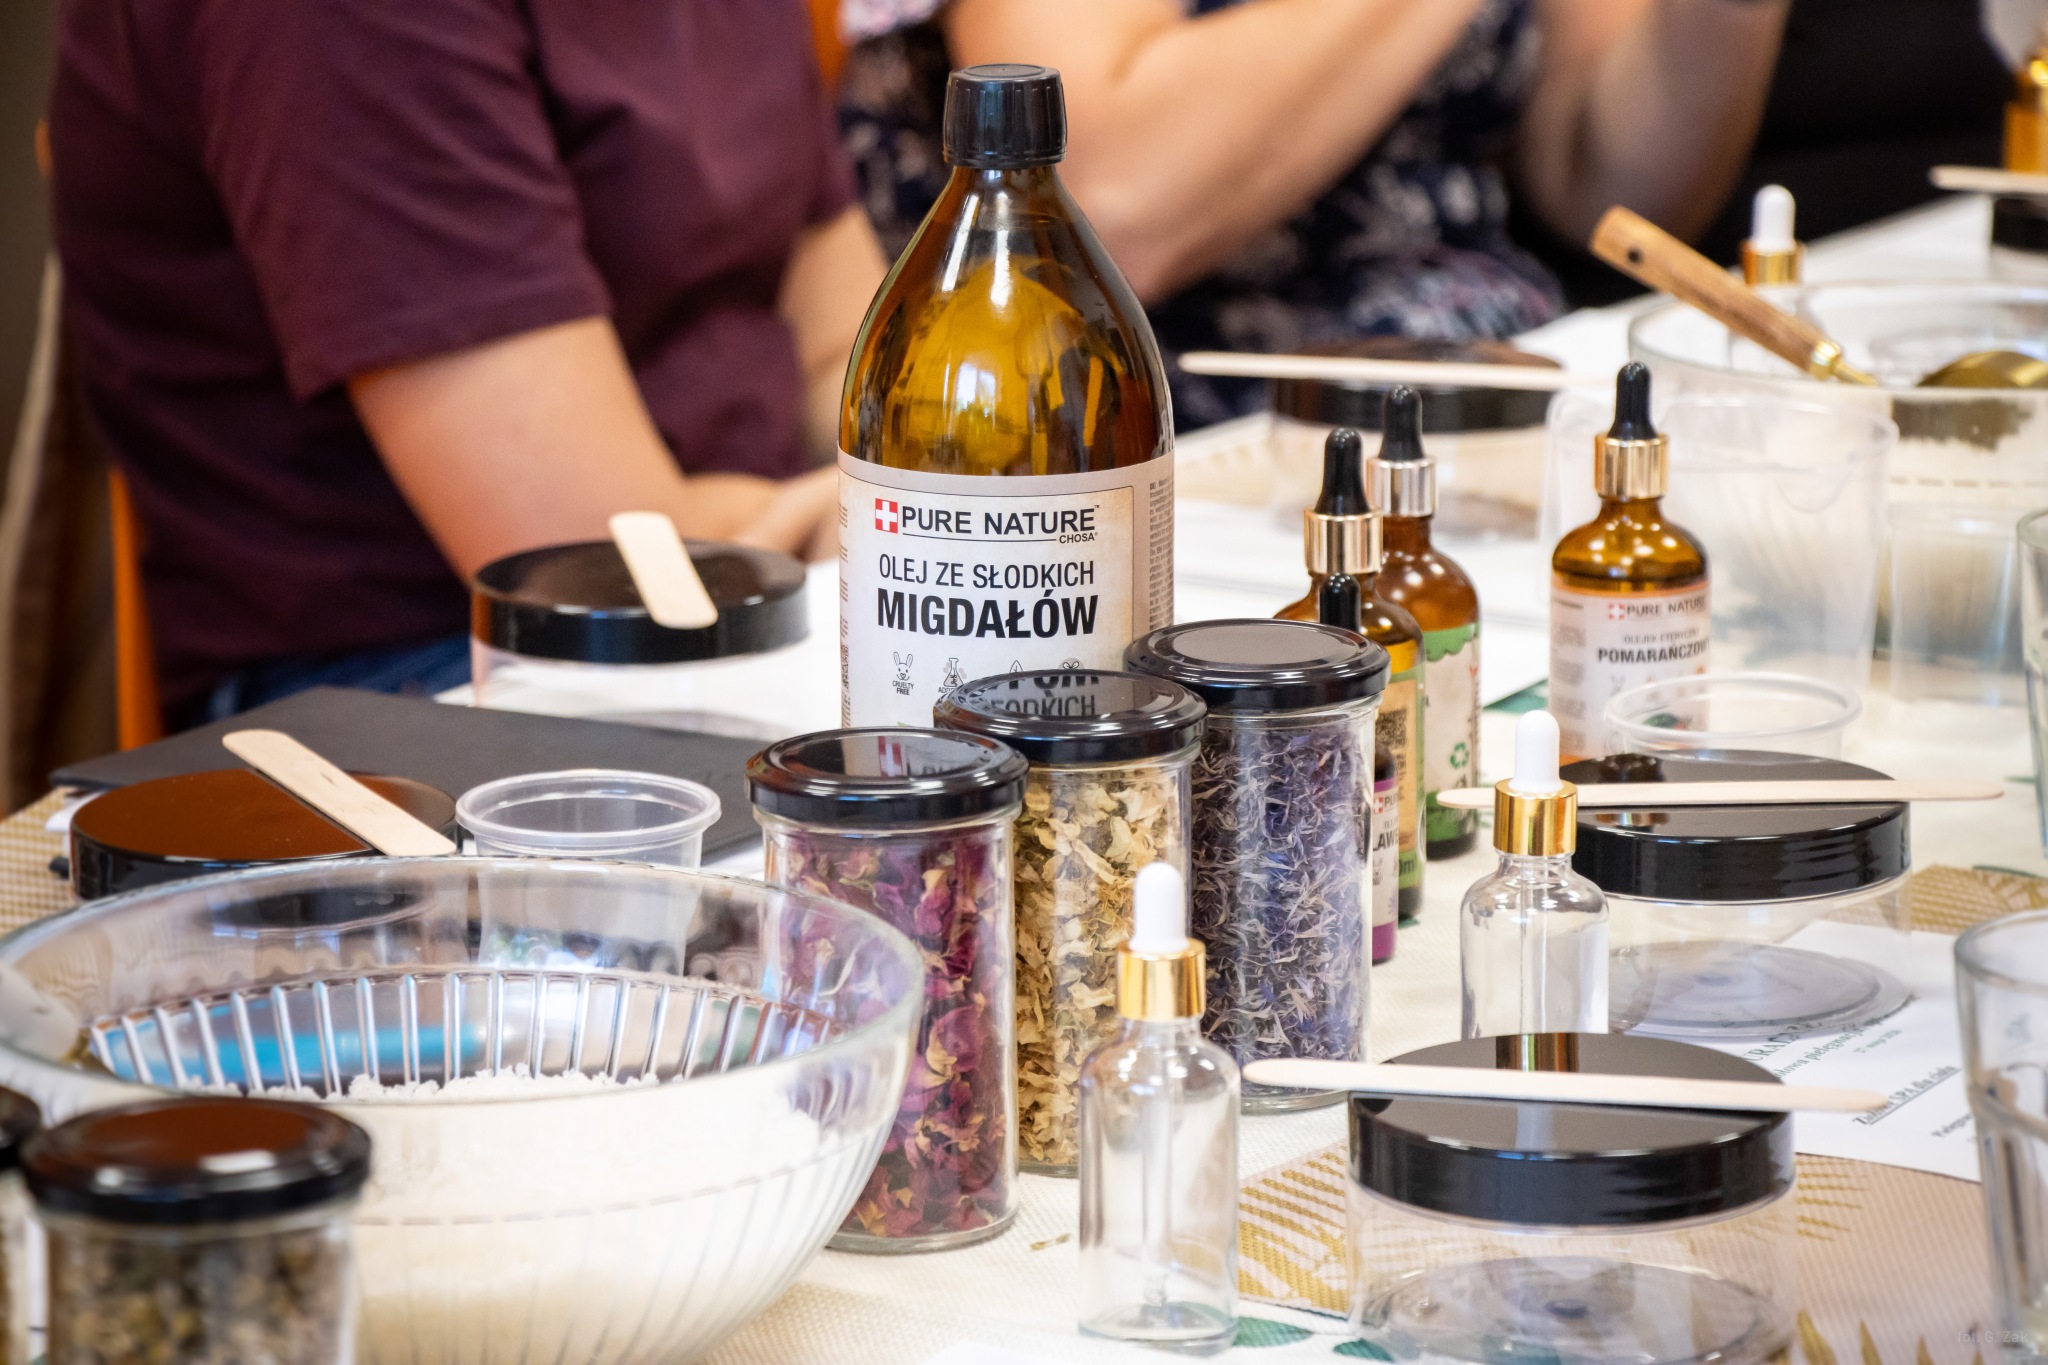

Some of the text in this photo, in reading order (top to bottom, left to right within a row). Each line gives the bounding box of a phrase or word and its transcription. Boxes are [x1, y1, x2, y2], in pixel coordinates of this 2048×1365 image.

[902, 506, 972, 534] PURE
[879, 553, 1094, 589] OLEJ ZE SŁODKICH
[877, 587, 1098, 639] MIGDAŁÓW
[892, 680, 914, 690] CRUELTY
[896, 687, 910, 696] FREE
